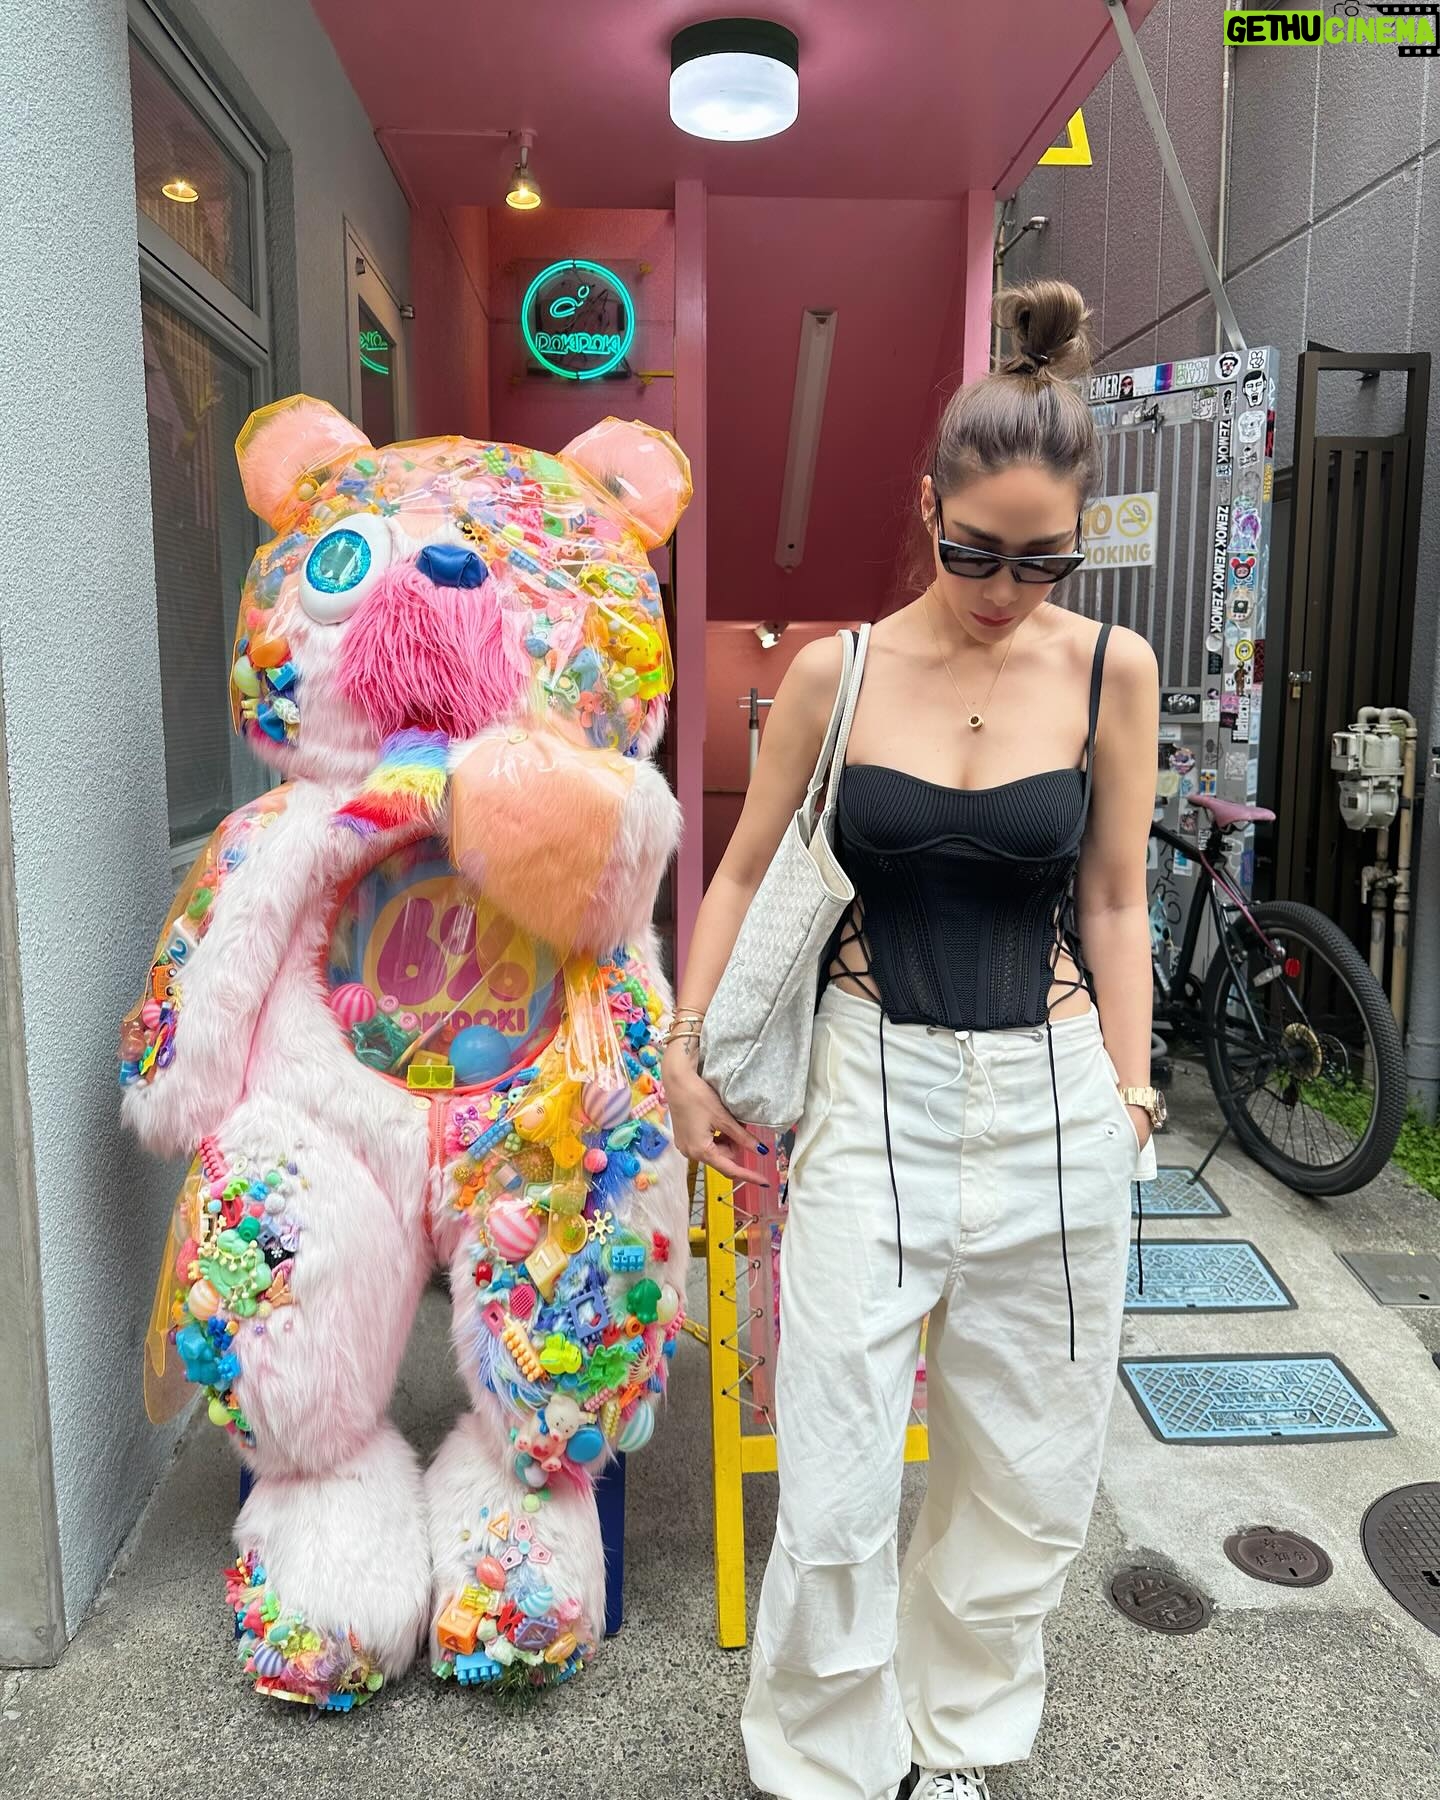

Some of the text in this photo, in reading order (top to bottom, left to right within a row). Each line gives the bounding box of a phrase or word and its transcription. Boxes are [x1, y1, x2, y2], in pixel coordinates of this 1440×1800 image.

[1217, 420, 1231, 464] ZEMOK
[1215, 505, 1229, 547] ZEMOK
[1086, 543, 1151, 565] OKING
[1212, 547, 1227, 589] ZEMOK
[1210, 588, 1225, 633] ZEMOK
[170, 937, 187, 965] 2
